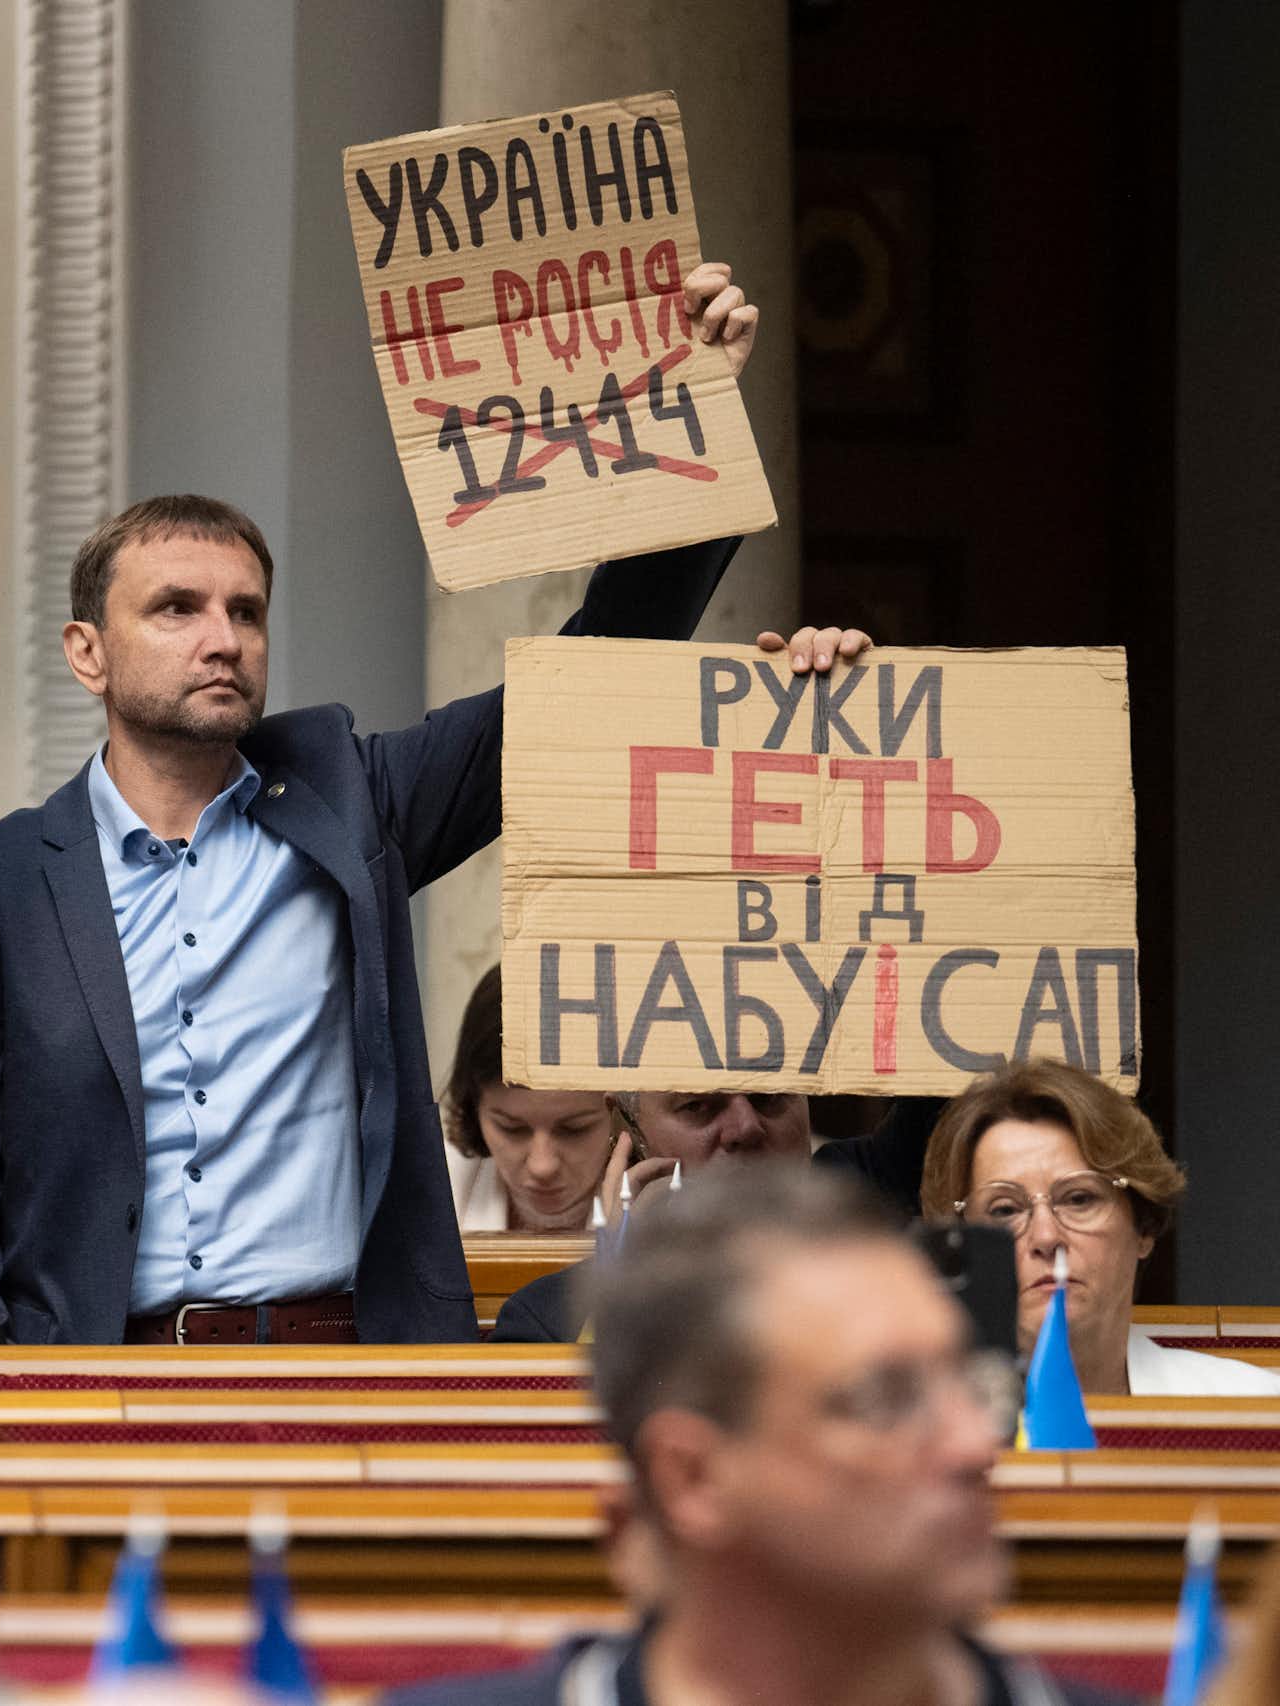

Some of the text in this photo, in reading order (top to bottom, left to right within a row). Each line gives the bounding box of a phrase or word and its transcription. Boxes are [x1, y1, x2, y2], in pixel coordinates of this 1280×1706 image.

[356, 113, 679, 270] УКРАЇНА
[380, 238, 694, 386] НЕ РОСІЯ
[437, 365, 707, 505] 12414
[699, 656, 943, 759] РУКИ
[628, 745, 1003, 874] ГЕТЬ
[539, 938, 868, 1075] НАБУ
[920, 945, 1138, 1078] САП
